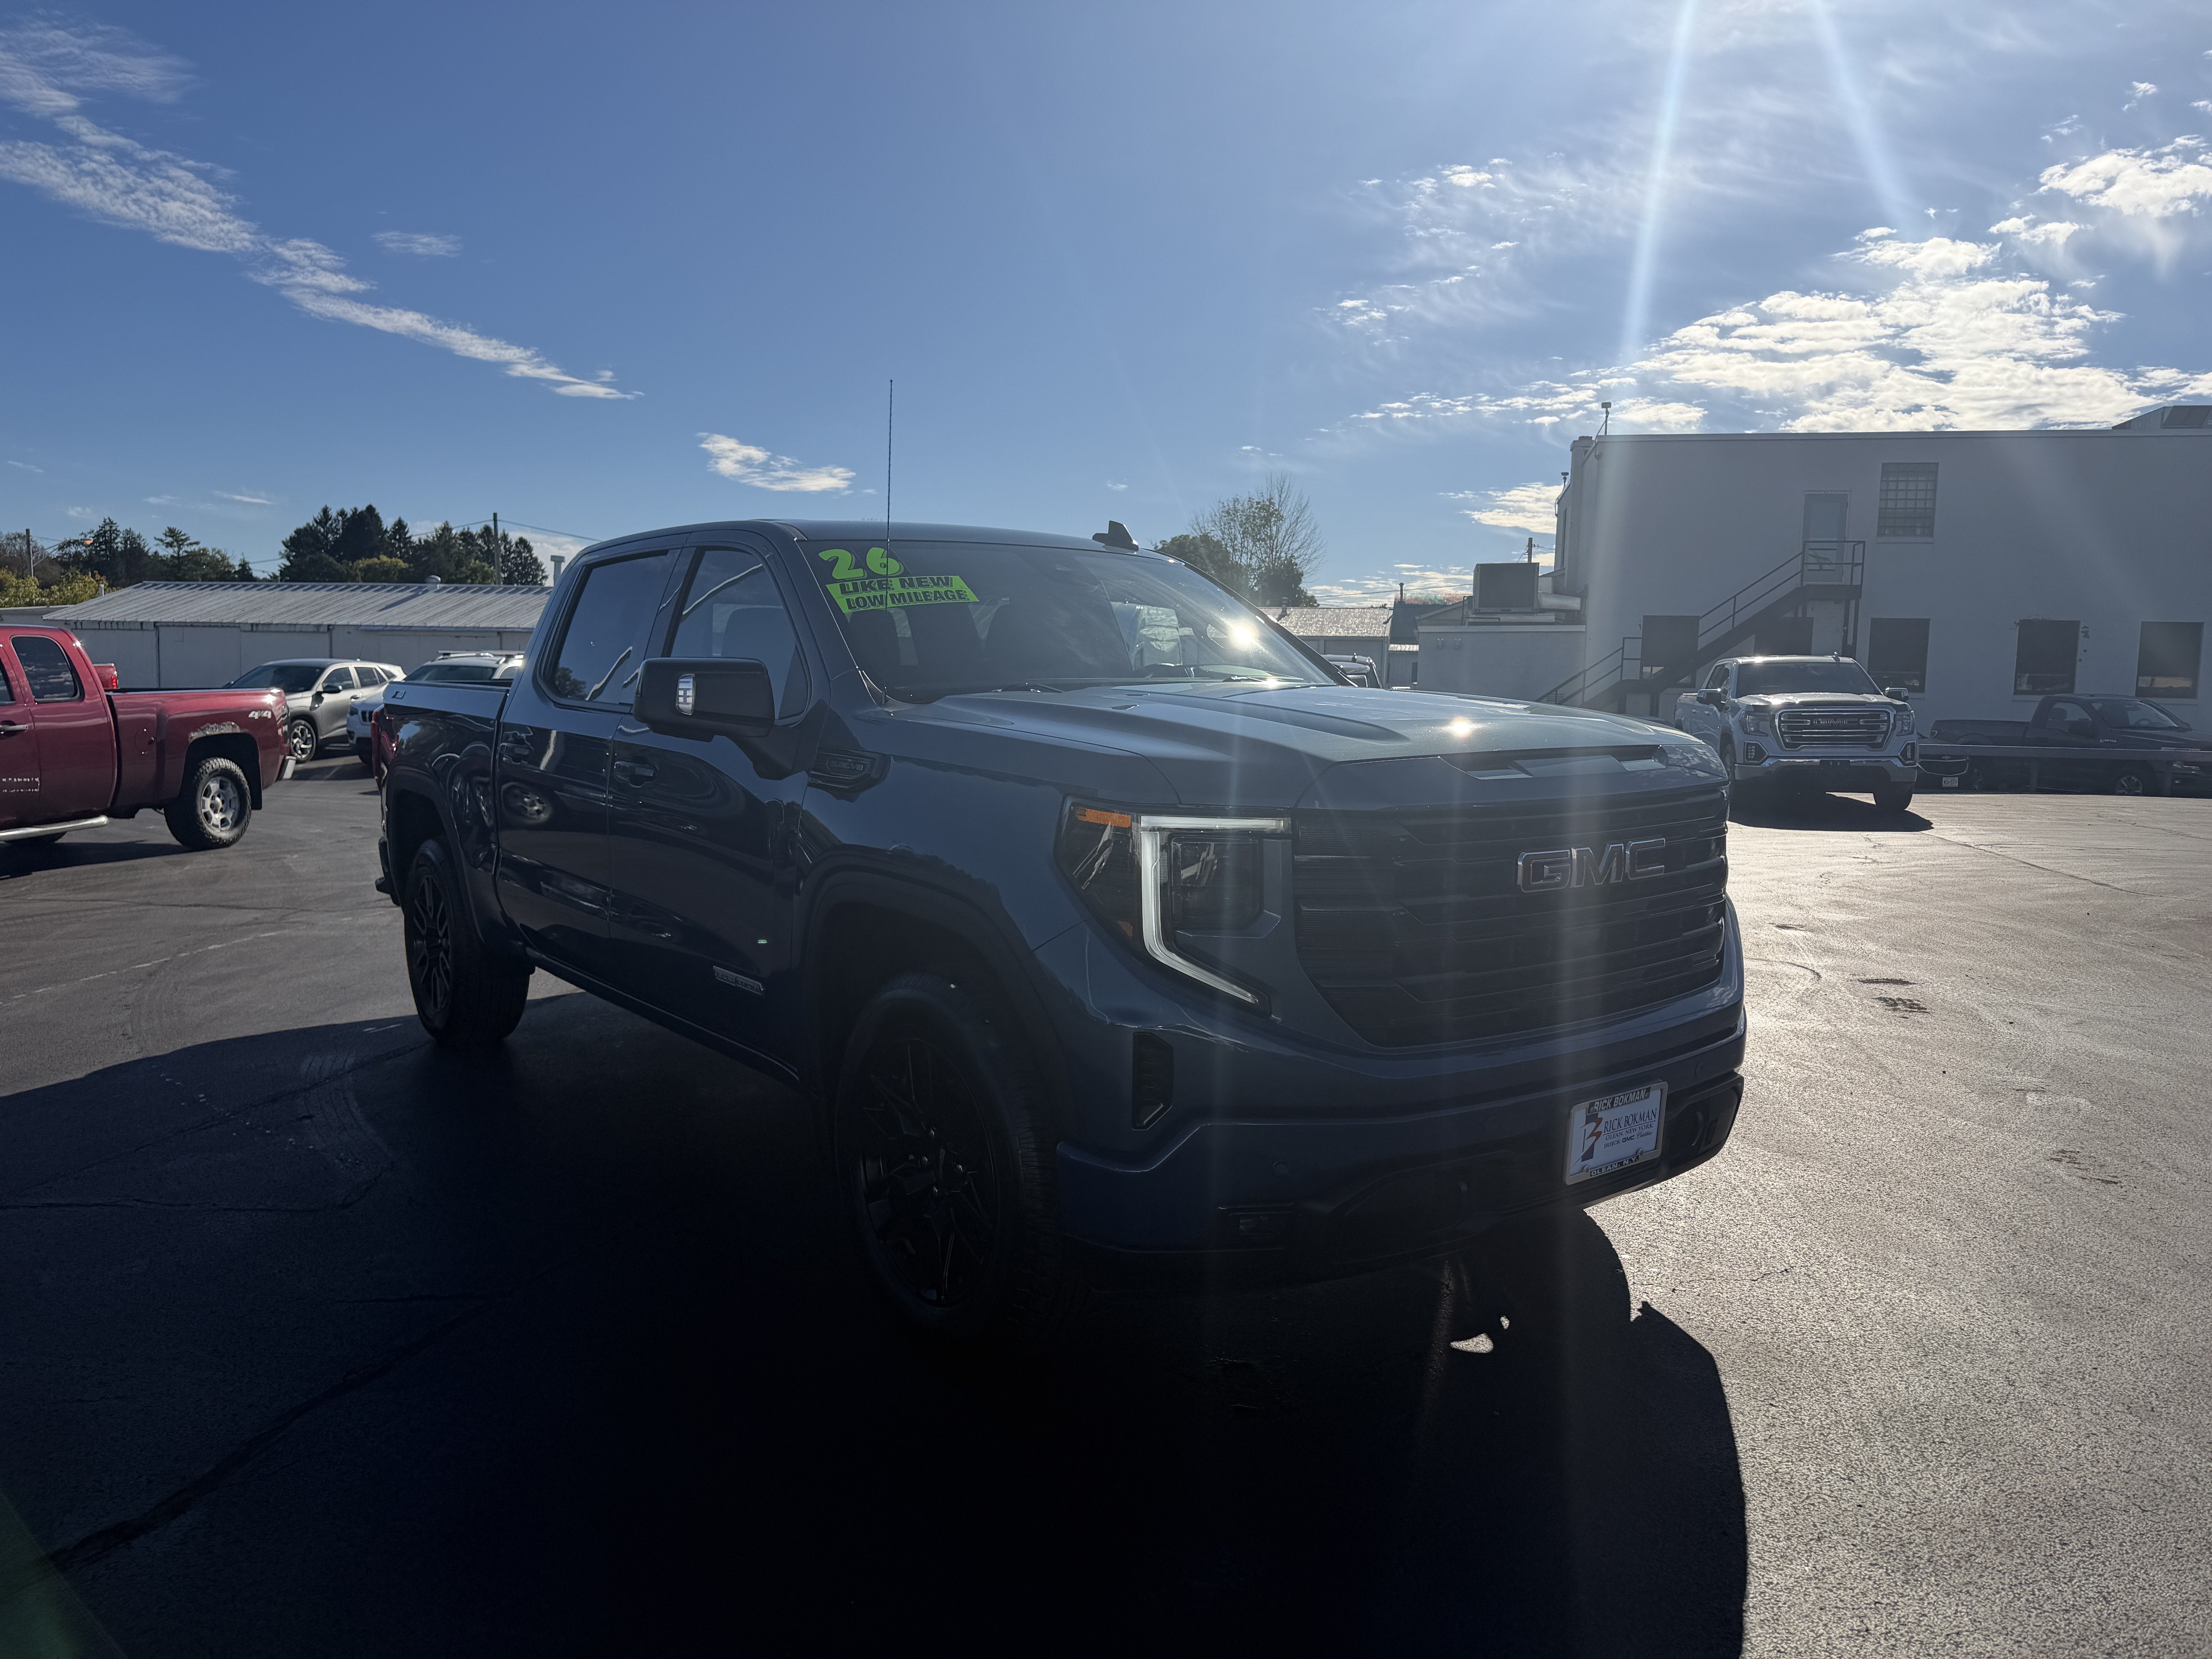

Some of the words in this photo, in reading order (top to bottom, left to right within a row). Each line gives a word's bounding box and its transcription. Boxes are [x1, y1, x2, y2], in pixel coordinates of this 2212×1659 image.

[818, 547, 903, 579] 26
[839, 578, 893, 596] LIKE
[899, 576, 953, 590] NEW
[846, 595, 885, 610] LOW
[889, 589, 970, 606] MILEAGE
[1516, 838, 1666, 893] GMC
[1594, 1098, 1613, 1112] RICK
[1613, 1089, 1646, 1107] BOKMAN
[1604, 1116, 1623, 1133] RICK
[1624, 1108, 1657, 1127] BOKMAN
[1637, 1123, 1653, 1131] YORK
[1604, 1139, 1621, 1148] BUICK
